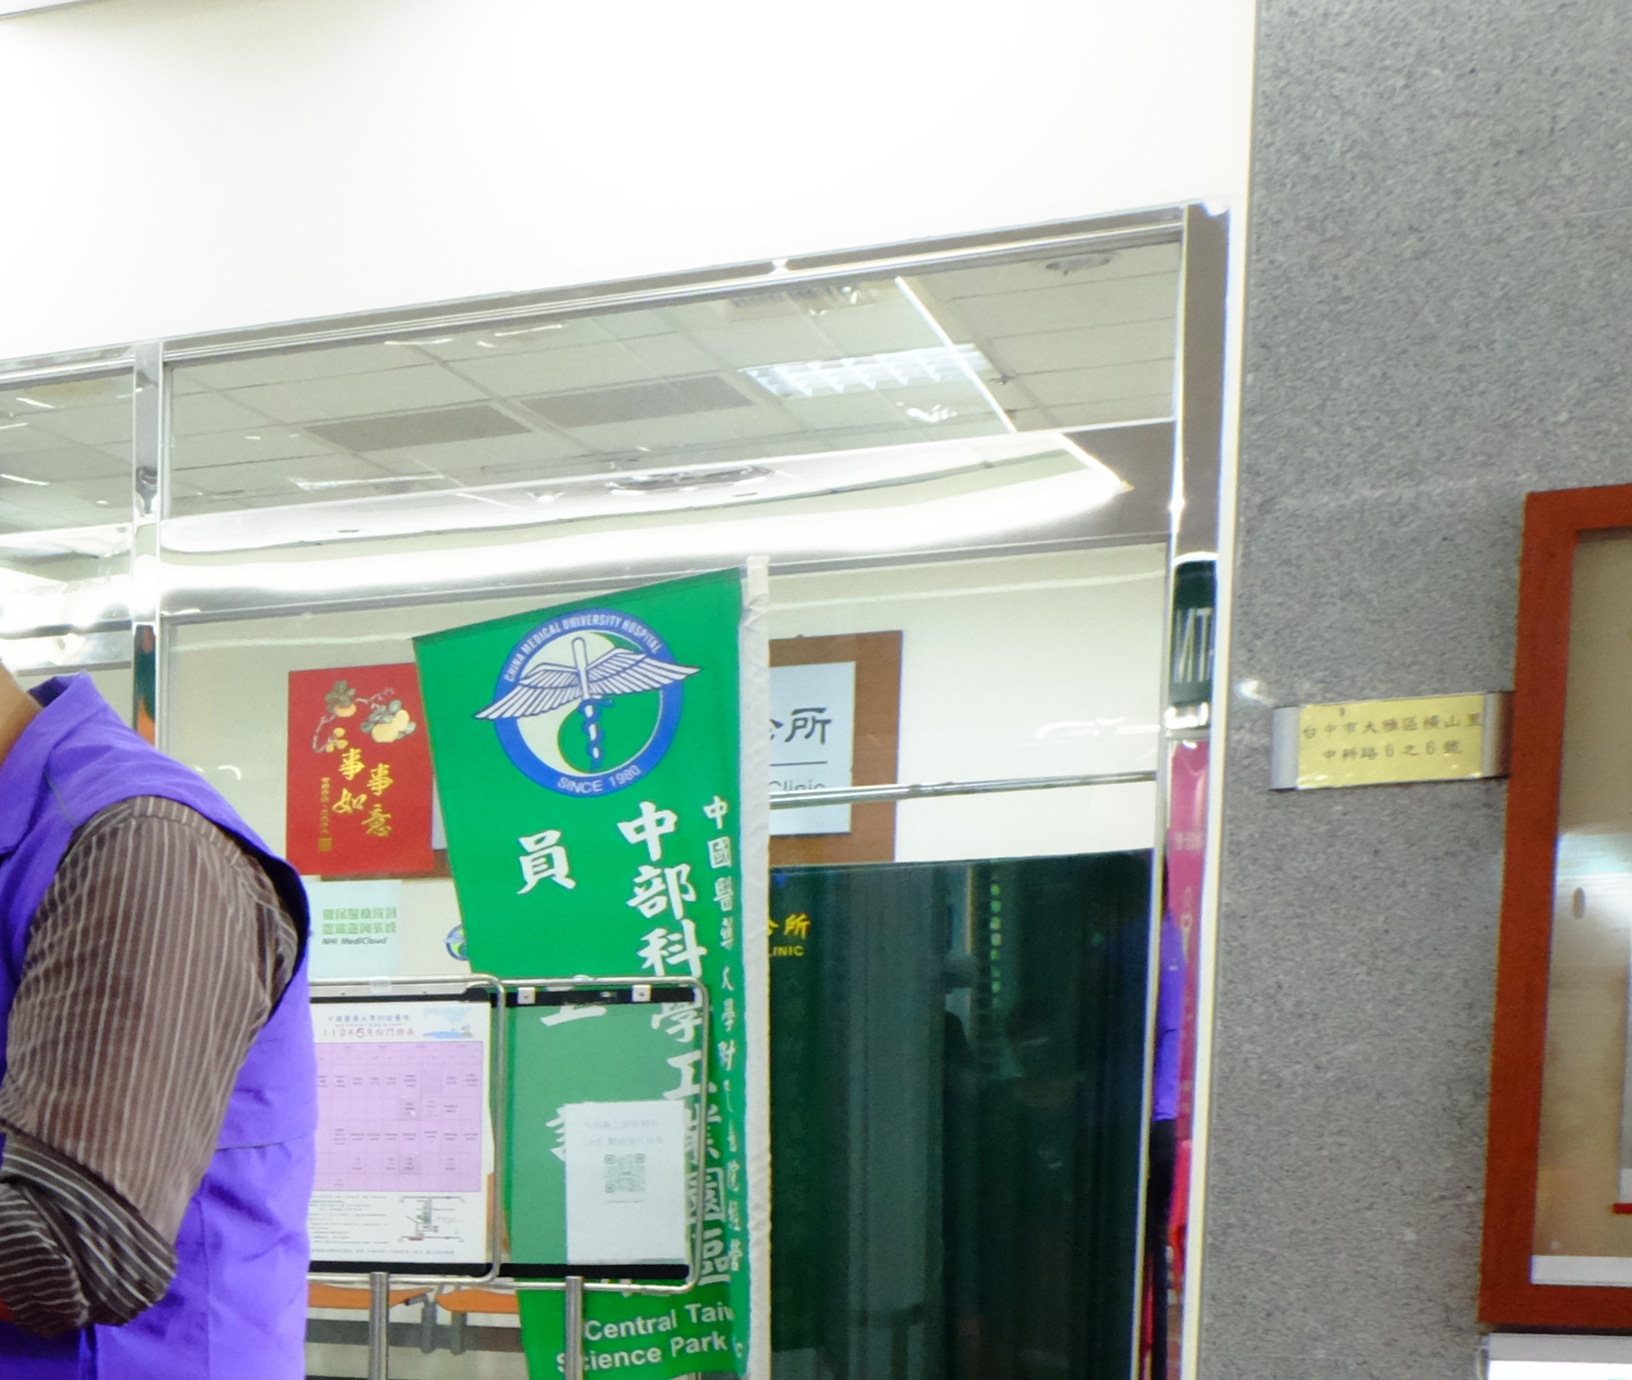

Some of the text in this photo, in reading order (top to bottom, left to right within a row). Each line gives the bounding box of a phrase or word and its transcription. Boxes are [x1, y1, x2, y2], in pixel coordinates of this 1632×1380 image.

[503, 614, 664, 682] CHINA MEDICAL UNIVERSITY HOSPITAL
[557, 764, 642, 794] SINCE 1980
[768, 913, 812, 940] 所
[584, 1310, 677, 1340] Central
[670, 1332, 727, 1359] Park
